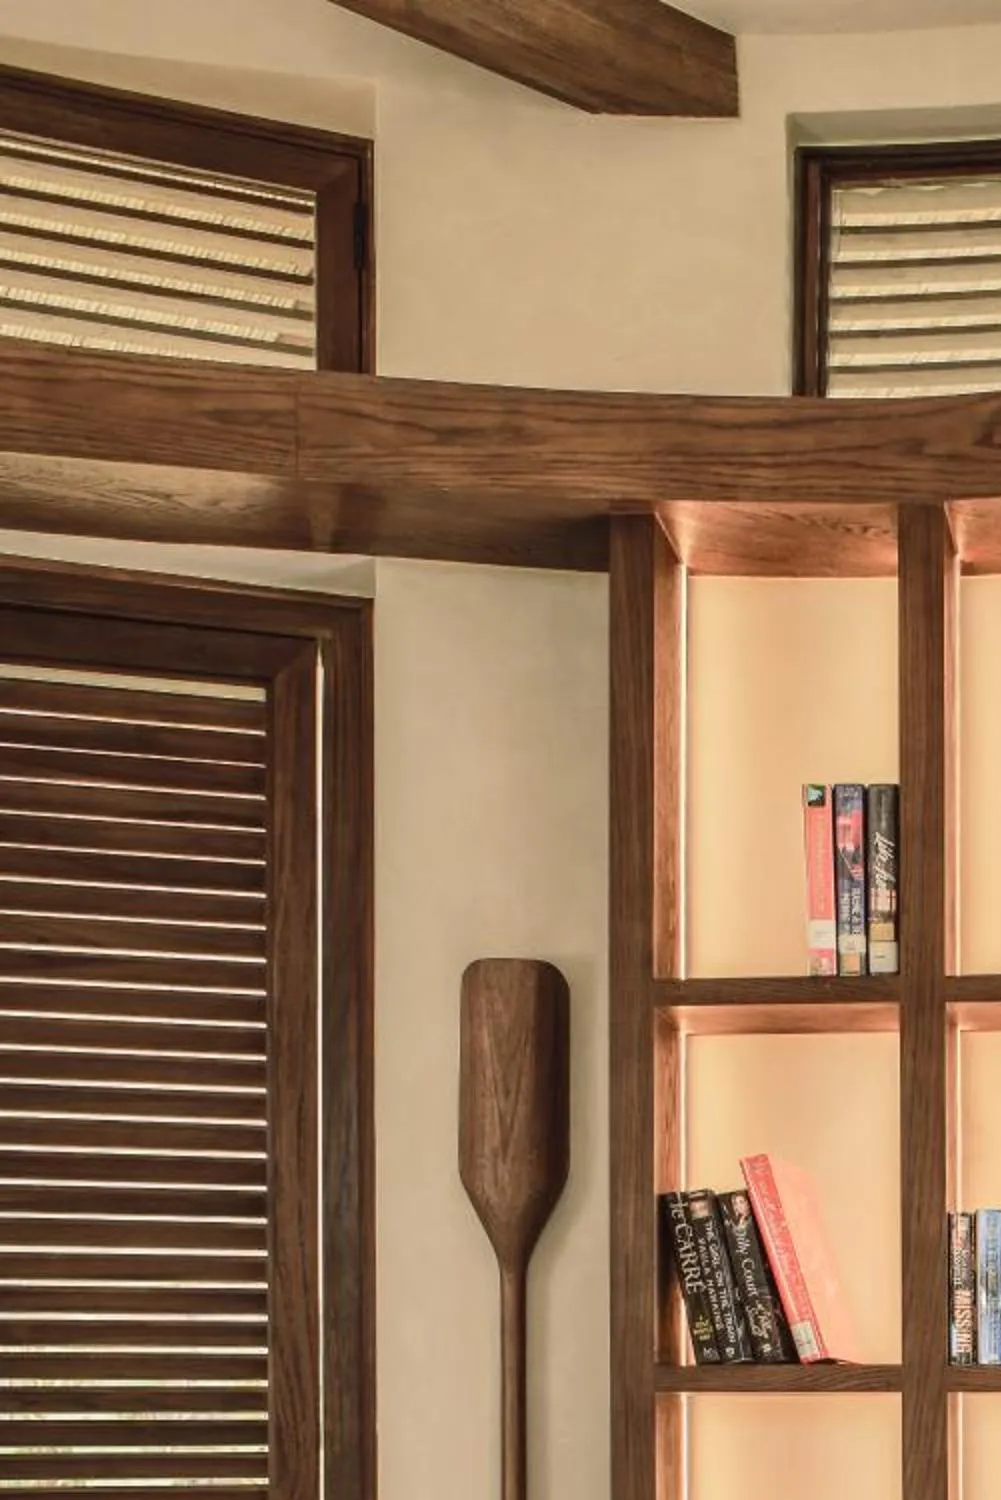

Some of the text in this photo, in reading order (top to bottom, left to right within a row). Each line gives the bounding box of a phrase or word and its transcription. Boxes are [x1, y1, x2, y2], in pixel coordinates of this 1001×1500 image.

[674, 1223, 706, 1296] CARRÉ
[697, 1237, 724, 1332] PAULA HAWKINS
[704, 1221, 737, 1344] THE GIRL ON THE TRAIN
[739, 1258, 760, 1297] Court
[954, 1289, 973, 1354] MISSING
